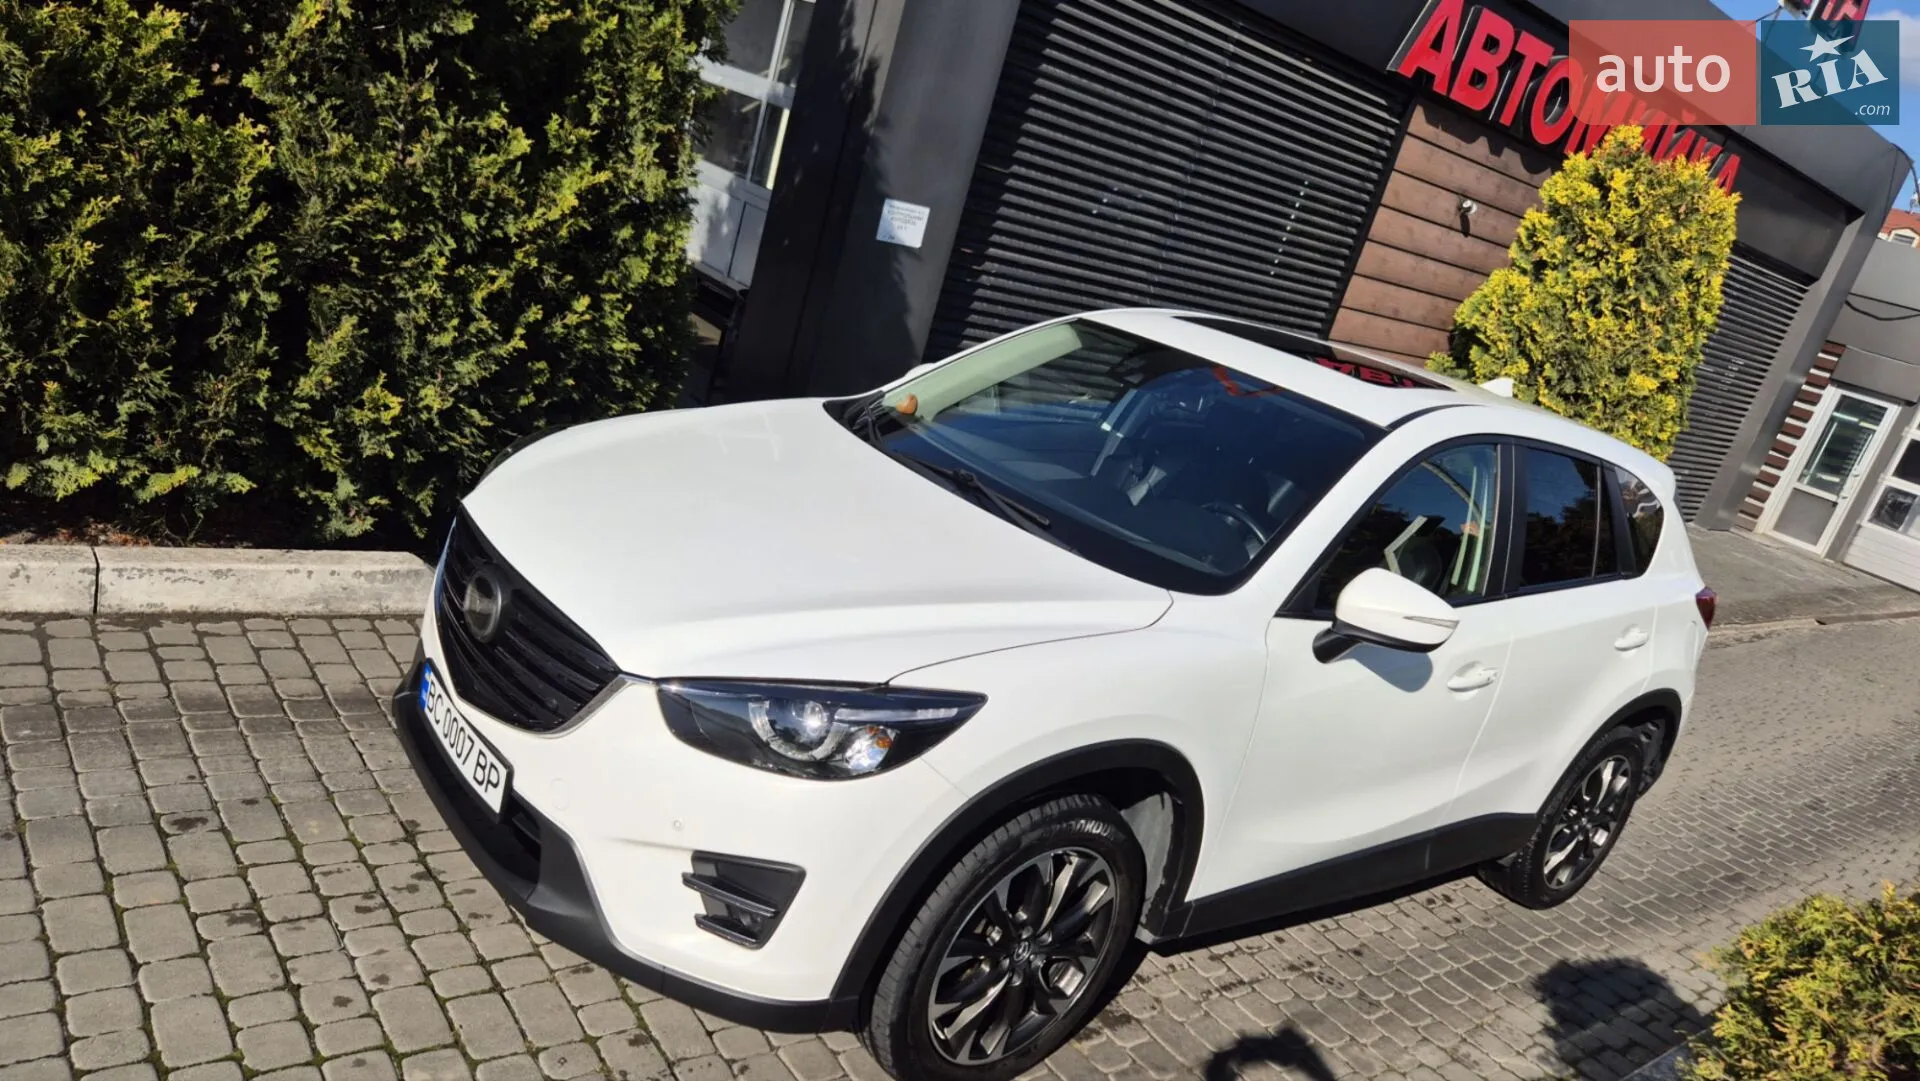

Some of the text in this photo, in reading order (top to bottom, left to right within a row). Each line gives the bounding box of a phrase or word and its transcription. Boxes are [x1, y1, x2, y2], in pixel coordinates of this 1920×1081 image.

[426, 681, 500, 793] BC 0007 BP
